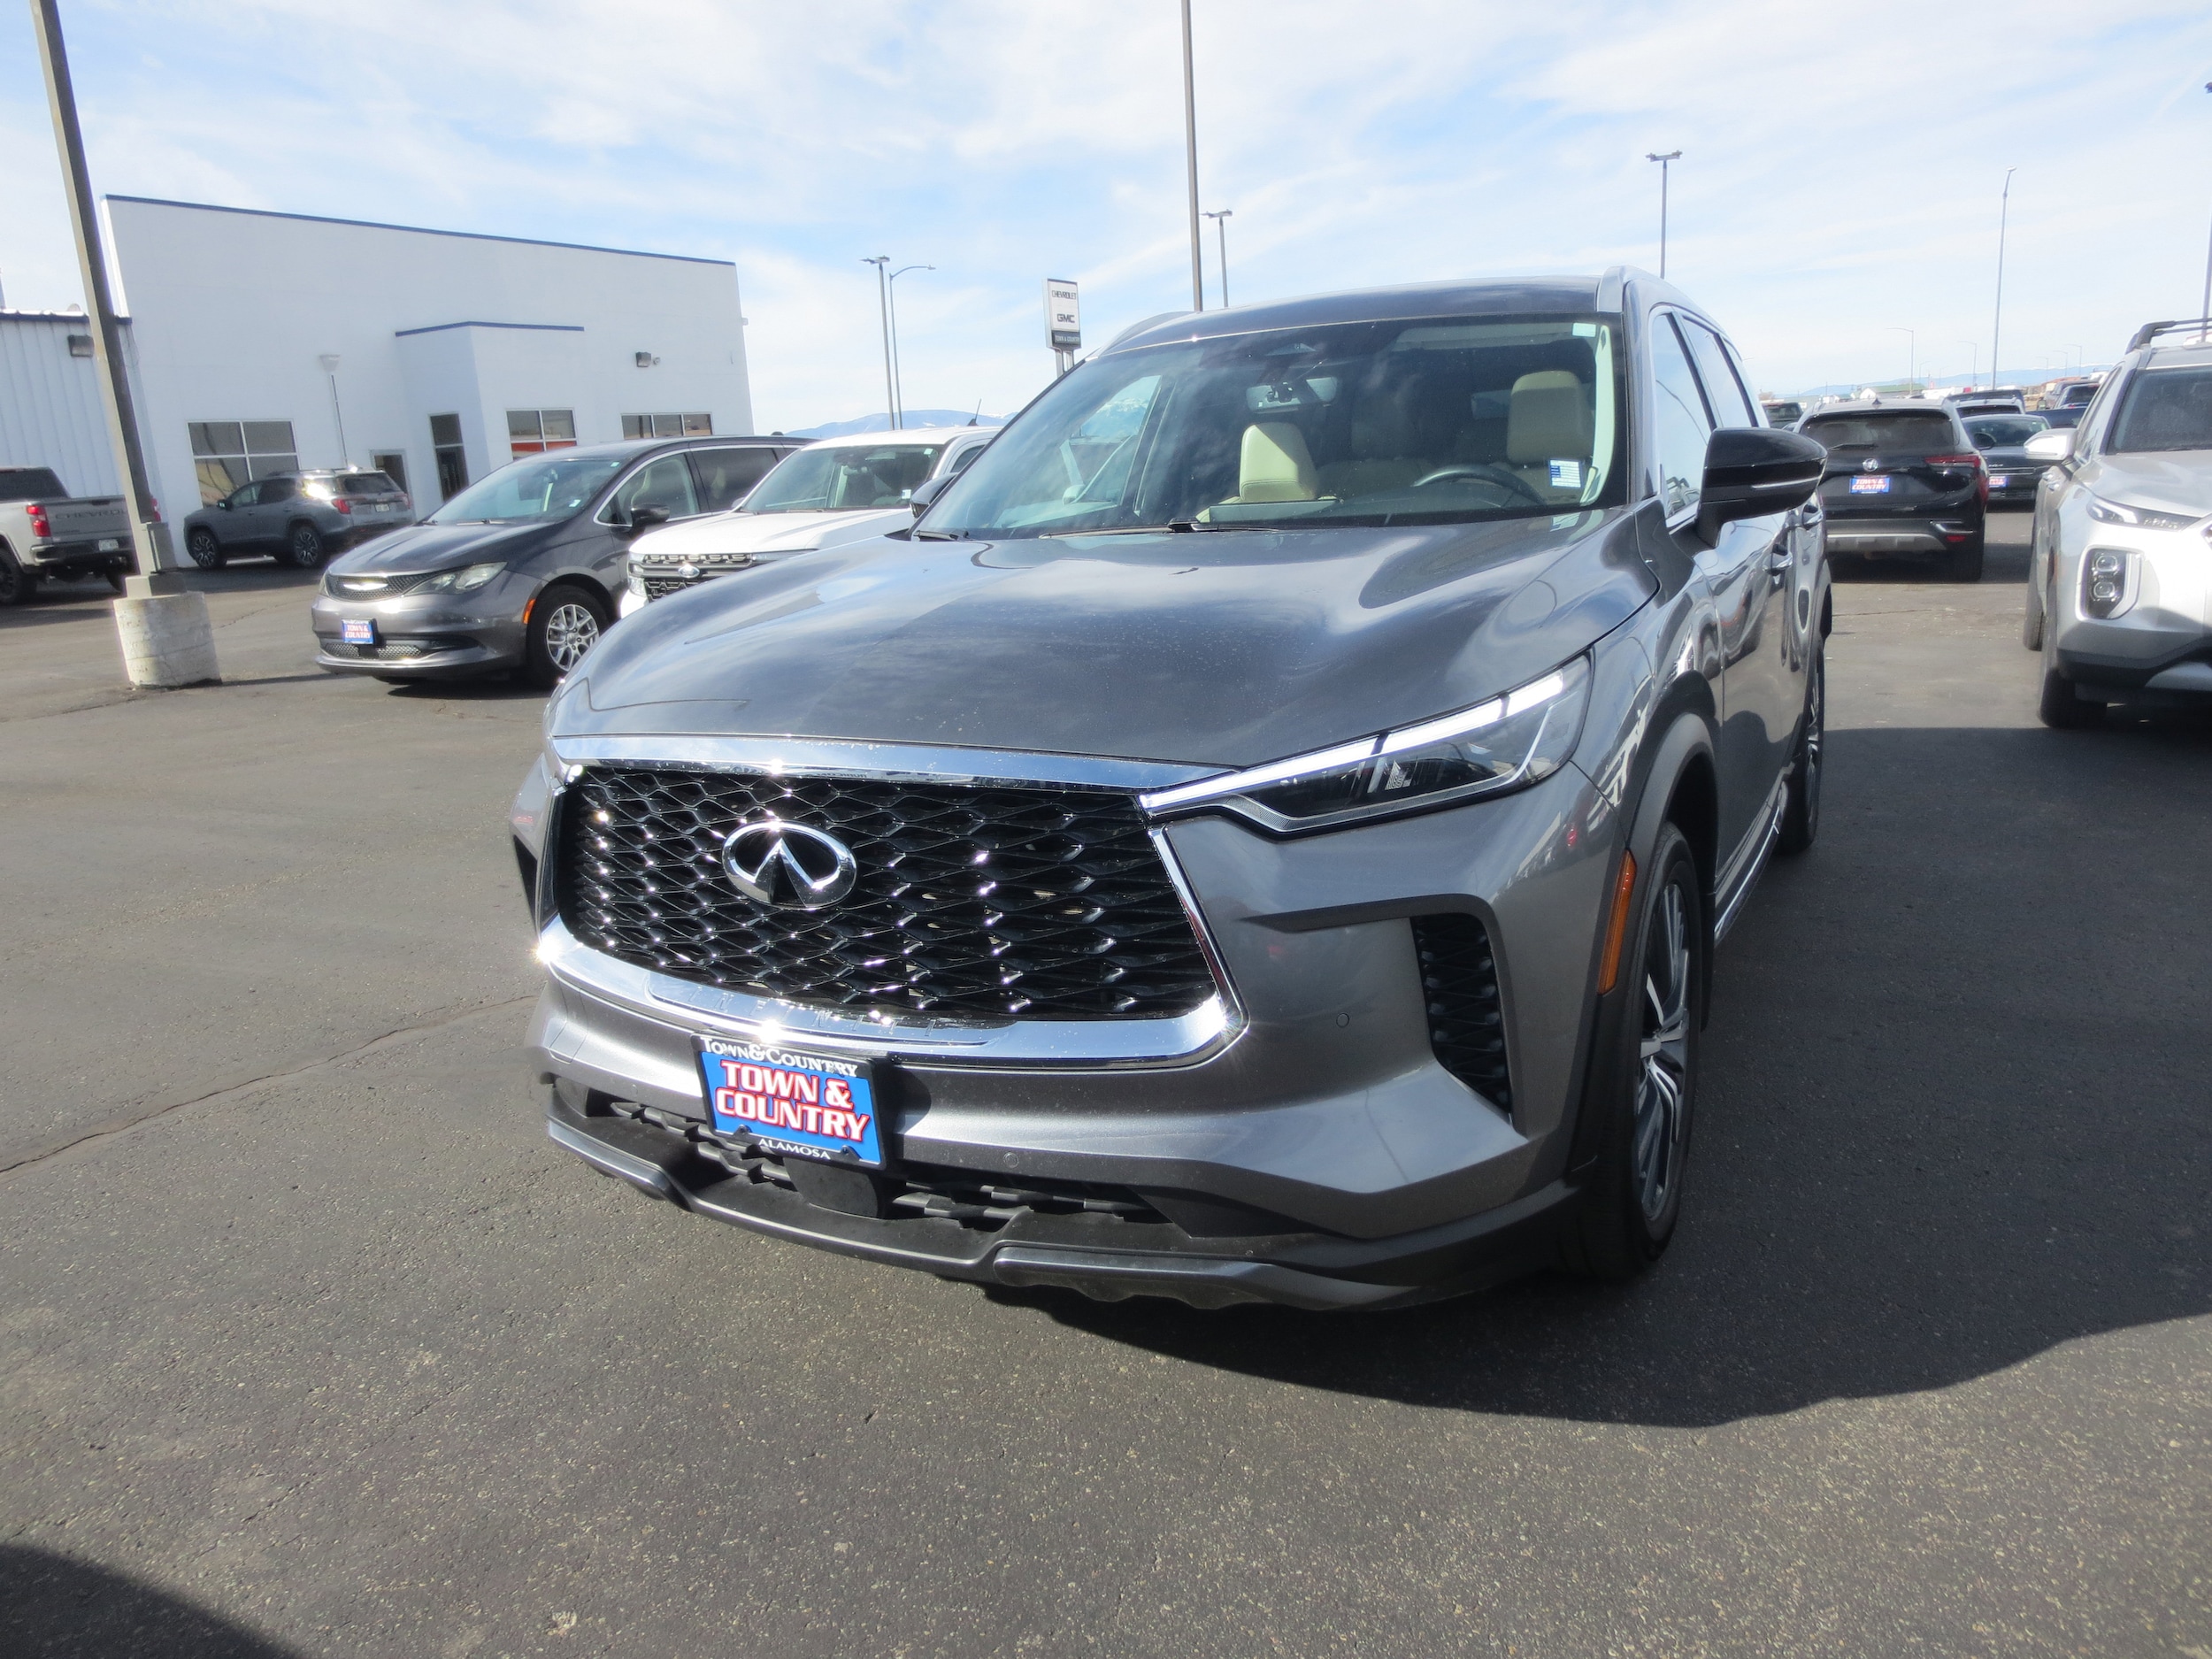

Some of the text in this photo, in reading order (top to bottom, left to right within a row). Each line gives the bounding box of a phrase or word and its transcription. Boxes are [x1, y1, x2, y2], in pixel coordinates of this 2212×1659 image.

[1051, 289, 1077, 300] CHEVROLET
[1056, 313, 1075, 324] GMC
[55, 508, 127, 519] CHEVROL
[720, 1059, 854, 1110] TOWN &
[715, 1087, 870, 1141] COUNTRY
[758, 1138, 831, 1160] ALAMOSA
